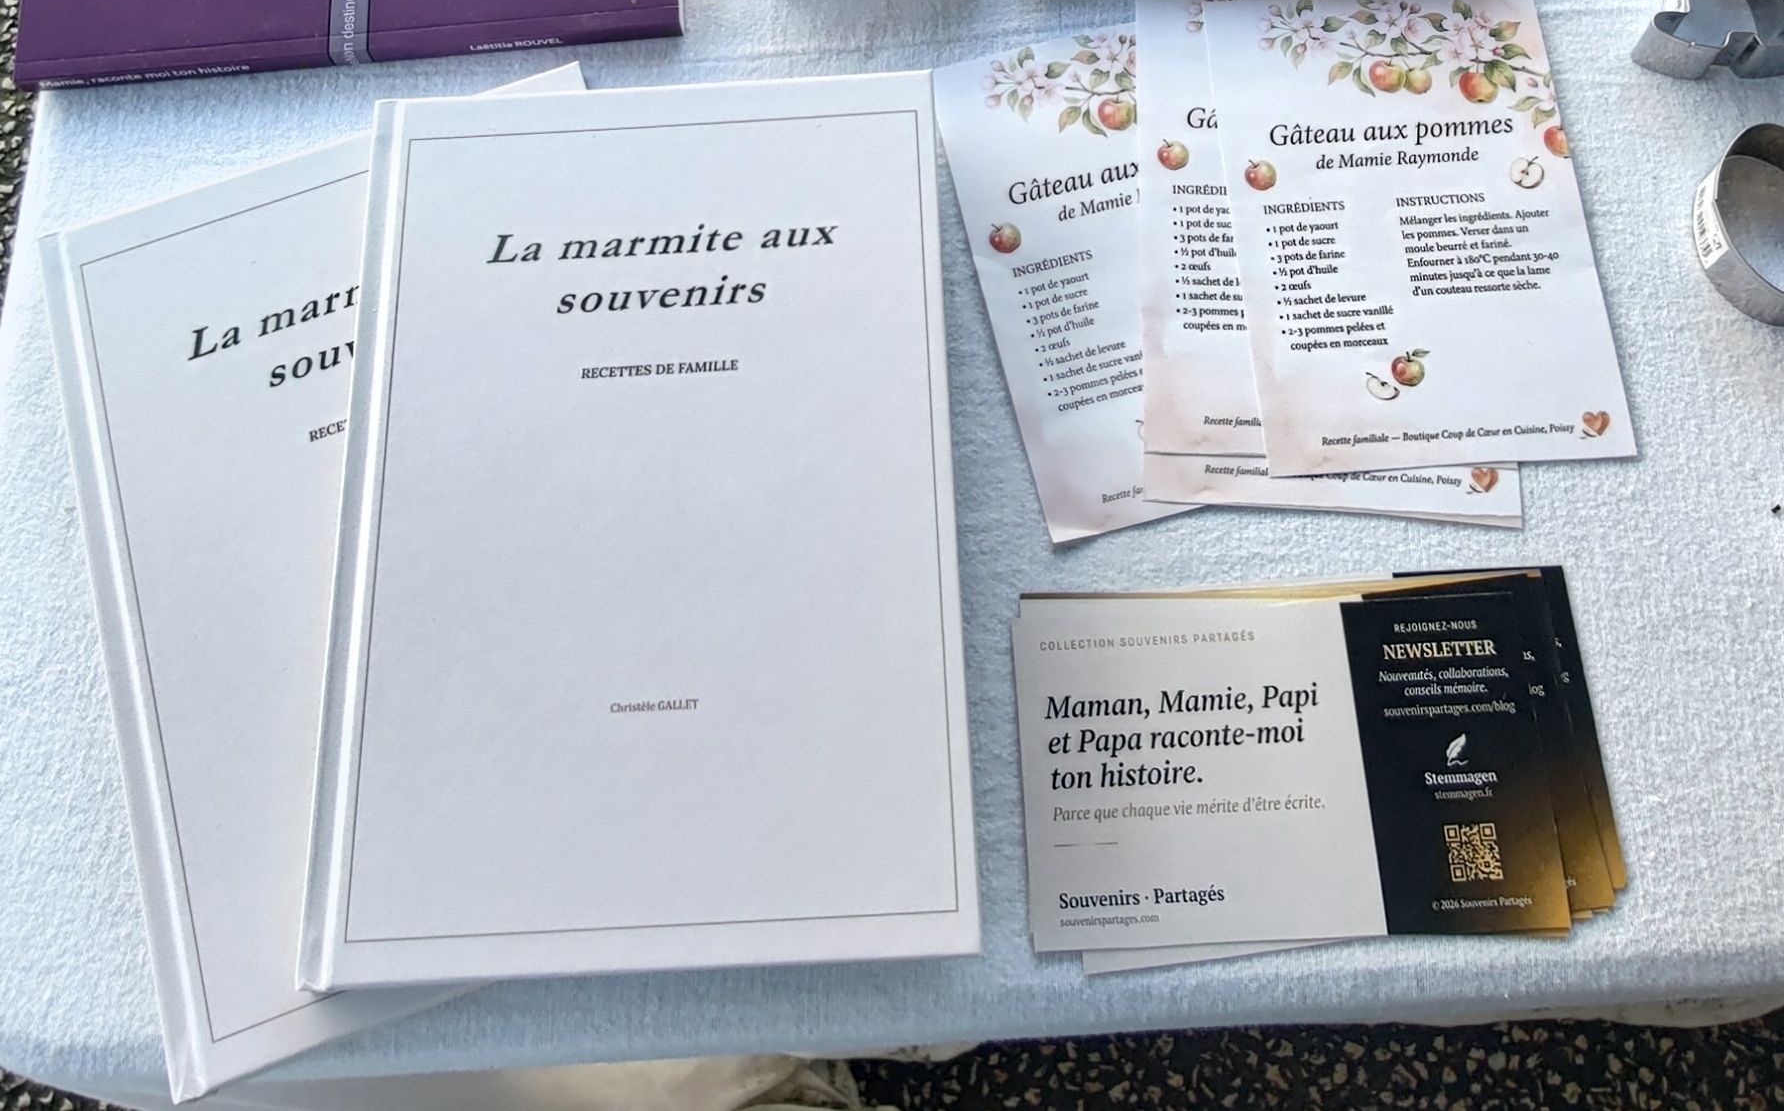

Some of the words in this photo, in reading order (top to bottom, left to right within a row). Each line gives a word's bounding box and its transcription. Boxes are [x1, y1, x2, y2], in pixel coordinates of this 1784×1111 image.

[515, 36, 563, 47] ROUVEL
[91, 73, 142, 84] raconte
[145, 70, 170, 79] moi
[173, 68, 196, 77] ton
[198, 63, 250, 74] histoire
[1269, 123, 1355, 146] Gâteau
[1364, 122, 1408, 141] aux
[1414, 117, 1513, 145] pommes
[1316, 155, 1333, 170] de
[1338, 152, 1392, 168] Mamie
[1397, 148, 1479, 169] Raymonde
[1009, 173, 1094, 204] Gâteau
[1101, 162, 1139, 184] aux
[1058, 205, 1076, 221] de
[1080, 193, 1133, 216] Mamie
[1264, 200, 1345, 215] INGRÉDIENTS
[1396, 193, 1485, 207] INSTRUCTIONS
[1400, 215, 1442, 226] Mélanger
[1444, 214, 1457, 223] les
[1459, 211, 1512, 224] ingrédients.
[1515, 209, 1549, 220] Ajouter
[1280, 224, 1294, 235] pot
[1297, 222, 1307, 231] de
[1309, 222, 1338, 234] yaourt
[1402, 231, 1415, 239] les
[1417, 229, 1459, 240] pommes.
[1460, 227, 1490, 236] Verser
[1492, 225, 1514, 234] dans
[1515, 225, 1529, 233] un
[486, 234, 541, 263] La
[558, 224, 743, 261] marmite
[761, 224, 838, 249] aux
[1405, 243, 1434, 253] moule
[1436, 242, 1467, 251] beurré
[1470, 241, 1479, 249] et
[1481, 239, 1511, 249] fariné.
[1012, 250, 1093, 278] INGRÉDIENTS
[1407, 257, 1454, 267] Enfourner
[1456, 256, 1462, 264] à
[1493, 252, 1531, 265] pendant
[1533, 252, 1559, 262] 30-40
[1410, 272, 1447, 282] minutes
[1485, 269, 1494, 277] ce
[1497, 269, 1514, 279] que
[1517, 266, 1525, 275] la
[1527, 266, 1550, 275] lame
[557, 275, 767, 314] souvenirs
[1436, 285, 1472, 295] couteau
[1474, 283, 1510, 293] ressorte
[1512, 280, 1541, 290] sèche.
[188, 326, 240, 360] La
[581, 364, 651, 379] RECETTES
[656, 363, 674, 375] DE
[678, 359, 738, 373] FAMILLE
[1322, 436, 1351, 446] Recette
[1352, 434, 1389, 446] familiale
[1403, 431, 1439, 442] Boutique
[1441, 430, 1463, 440] Coup
[1465, 429, 1475, 437] de
[1514, 425, 1548, 435] Cuisine,
[1549, 423, 1574, 434] Poissy
[1394, 620, 1477, 633] REJOIGNEZ-NOUS
[1040, 638, 1114, 651] COLLECTION
[1120, 634, 1187, 647] SOUVENIRS
[1193, 630, 1255, 644] PARTAGÉS
[1382, 639, 1497, 660] NEWSLETTER
[1379, 669, 1437, 682] Nouveautés,
[1438, 666, 1509, 679] collaborations,
[1404, 684, 1441, 696] conseils
[1444, 683, 1488, 694] mémoire.
[610, 701, 655, 713] Christèle
[658, 699, 699, 710] GALLET
[1045, 696, 1150, 719] Maman,
[1158, 686, 1254, 714] Mamie,
[1261, 682, 1318, 713] Papi
[1384, 700, 1516, 718] souvenirspartages.com/blog
[1048, 732, 1071, 754] et
[1077, 729, 1142, 757] Papa
[1150, 718, 1305, 749] raconte-moi
[1051, 767, 1092, 790] ton
[1100, 760, 1203, 787] histoire.
[1425, 771, 1498, 786] Stemmagen
[1435, 787, 1493, 800] stemmagen.fr
[1053, 806, 1090, 821] Parce
[1094, 809, 1118, 822] que
[1122, 803, 1170, 820] chaque
[1174, 801, 1193, 815] vie
[1197, 798, 1239, 814] mérite
[1243, 796, 1281, 813] d'être
[1284, 795, 1325, 810] écrite.
[1059, 889, 1140, 909] Souvenirs
[1153, 885, 1225, 905] Partagés
[1441, 899, 1460, 909] 2026
[1461, 897, 1498, 909] Souvenirs
[1499, 895, 1533, 908] Partagés
[1060, 914, 1159, 927] souvenirspartages.com
